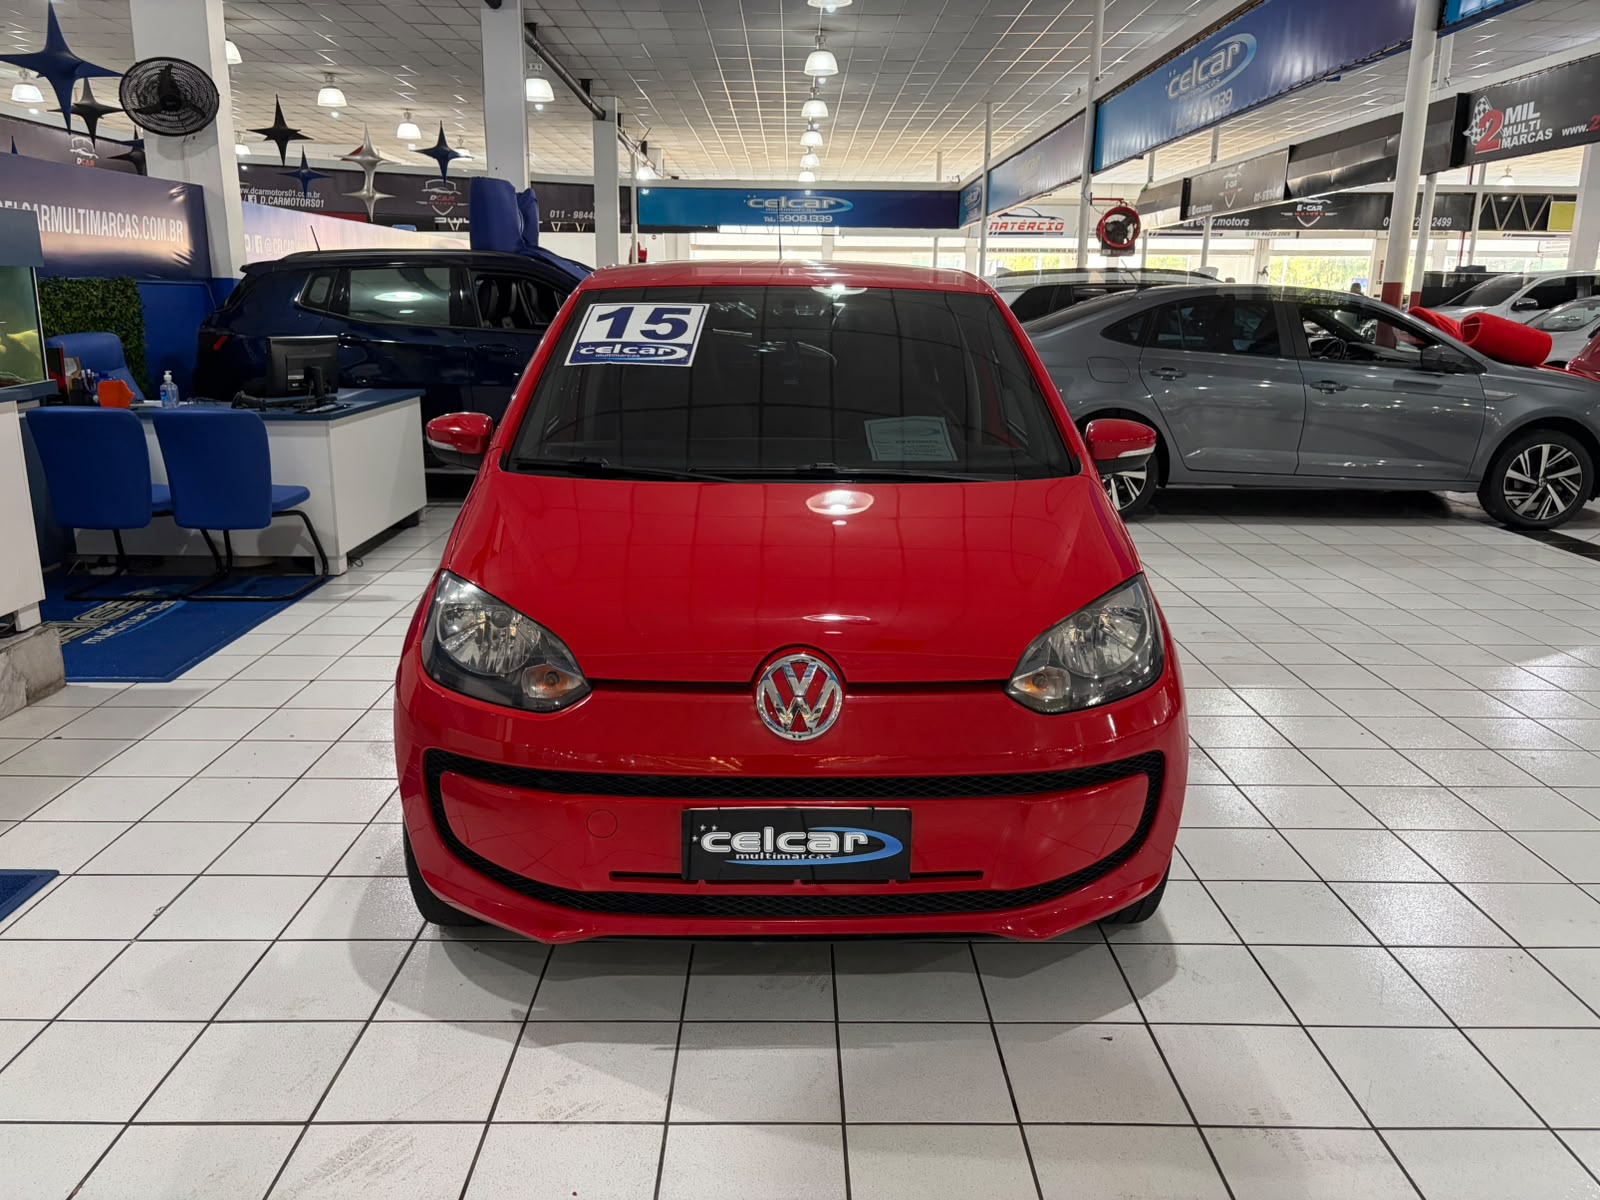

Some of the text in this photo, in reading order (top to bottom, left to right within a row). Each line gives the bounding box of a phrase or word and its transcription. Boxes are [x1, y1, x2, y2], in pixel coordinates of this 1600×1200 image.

[1167, 41, 1241, 100] celcar
[1504, 101, 1541, 125] MIL
[1503, 118, 1541, 138] MULTI
[1501, 128, 1553, 149] MARCAS
[747, 196, 837, 209] celcar
[549, 210, 565, 218] 011
[597, 307, 692, 341] 15
[580, 344, 671, 355] celcar
[701, 826, 869, 853] celcar
[736, 852, 832, 861] multimarcas
